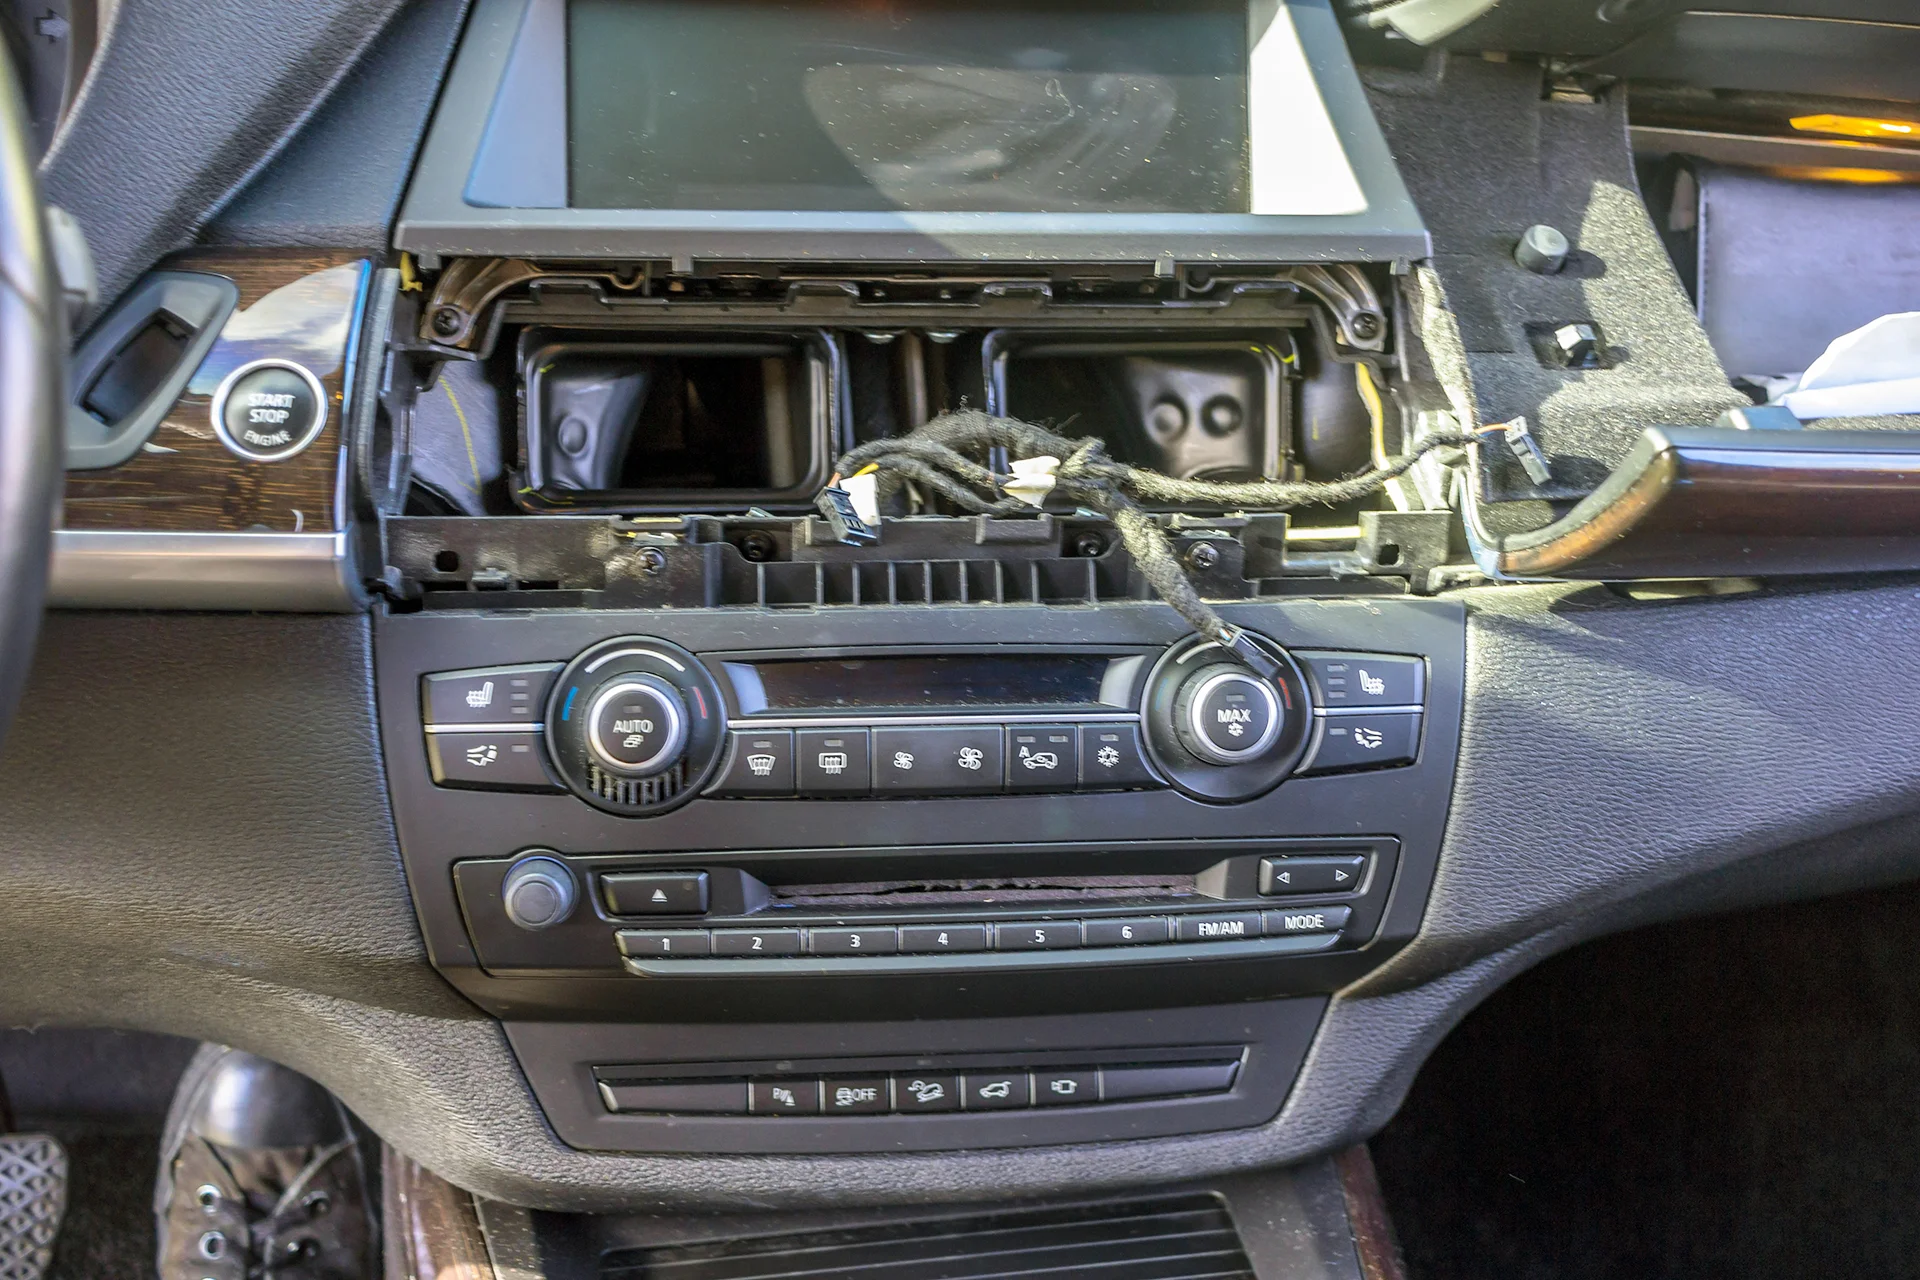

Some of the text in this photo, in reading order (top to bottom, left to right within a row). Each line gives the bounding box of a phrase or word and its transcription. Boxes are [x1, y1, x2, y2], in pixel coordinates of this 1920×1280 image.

[248, 393, 296, 408] START
[249, 409, 290, 423] STOP
[243, 430, 292, 446] ENGINE
[1217, 708, 1252, 723] MAX
[613, 719, 654, 733] AUTO
[1198, 921, 1245, 936] FM/AM
[1284, 914, 1325, 930] MODE
[937, 931, 949, 946] 4
[1034, 929, 1046, 943] 5
[1121, 925, 1133, 939] 6
[661, 937, 671, 951] 1
[751, 936, 763, 950] 2
[850, 934, 861, 948] 3
[853, 1087, 877, 1100] OFF
